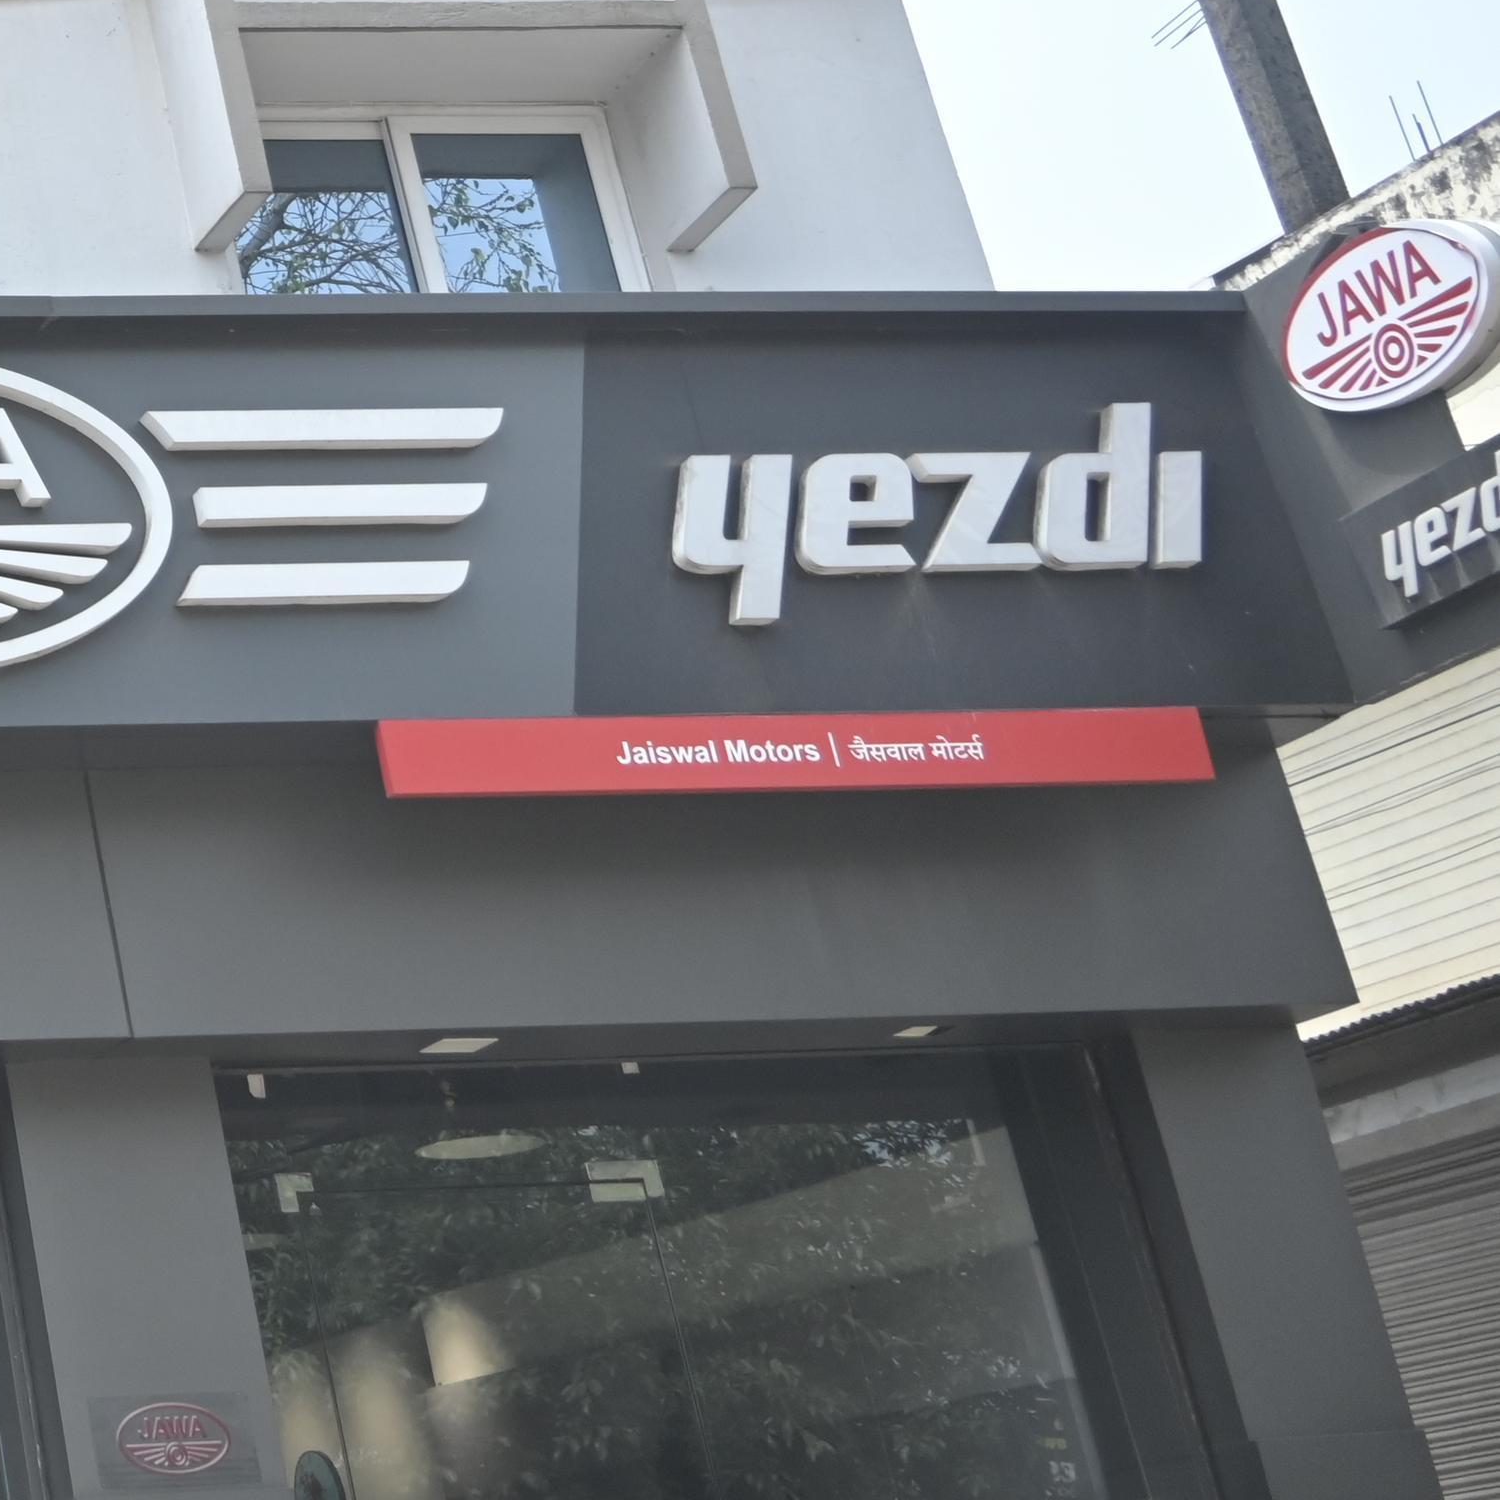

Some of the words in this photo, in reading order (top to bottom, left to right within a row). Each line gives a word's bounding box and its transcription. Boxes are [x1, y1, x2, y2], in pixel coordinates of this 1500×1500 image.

[1316, 240, 1443, 348] JAWA
[671, 401, 1203, 627] yezdi
[616, 740, 719, 765] Jaiswal
[723, 739, 821, 763] Motors
[847, 735, 926, 763] जैसवाल
[929, 734, 985, 761] मोटर्स
[137, 1414, 208, 1440] JAWA
